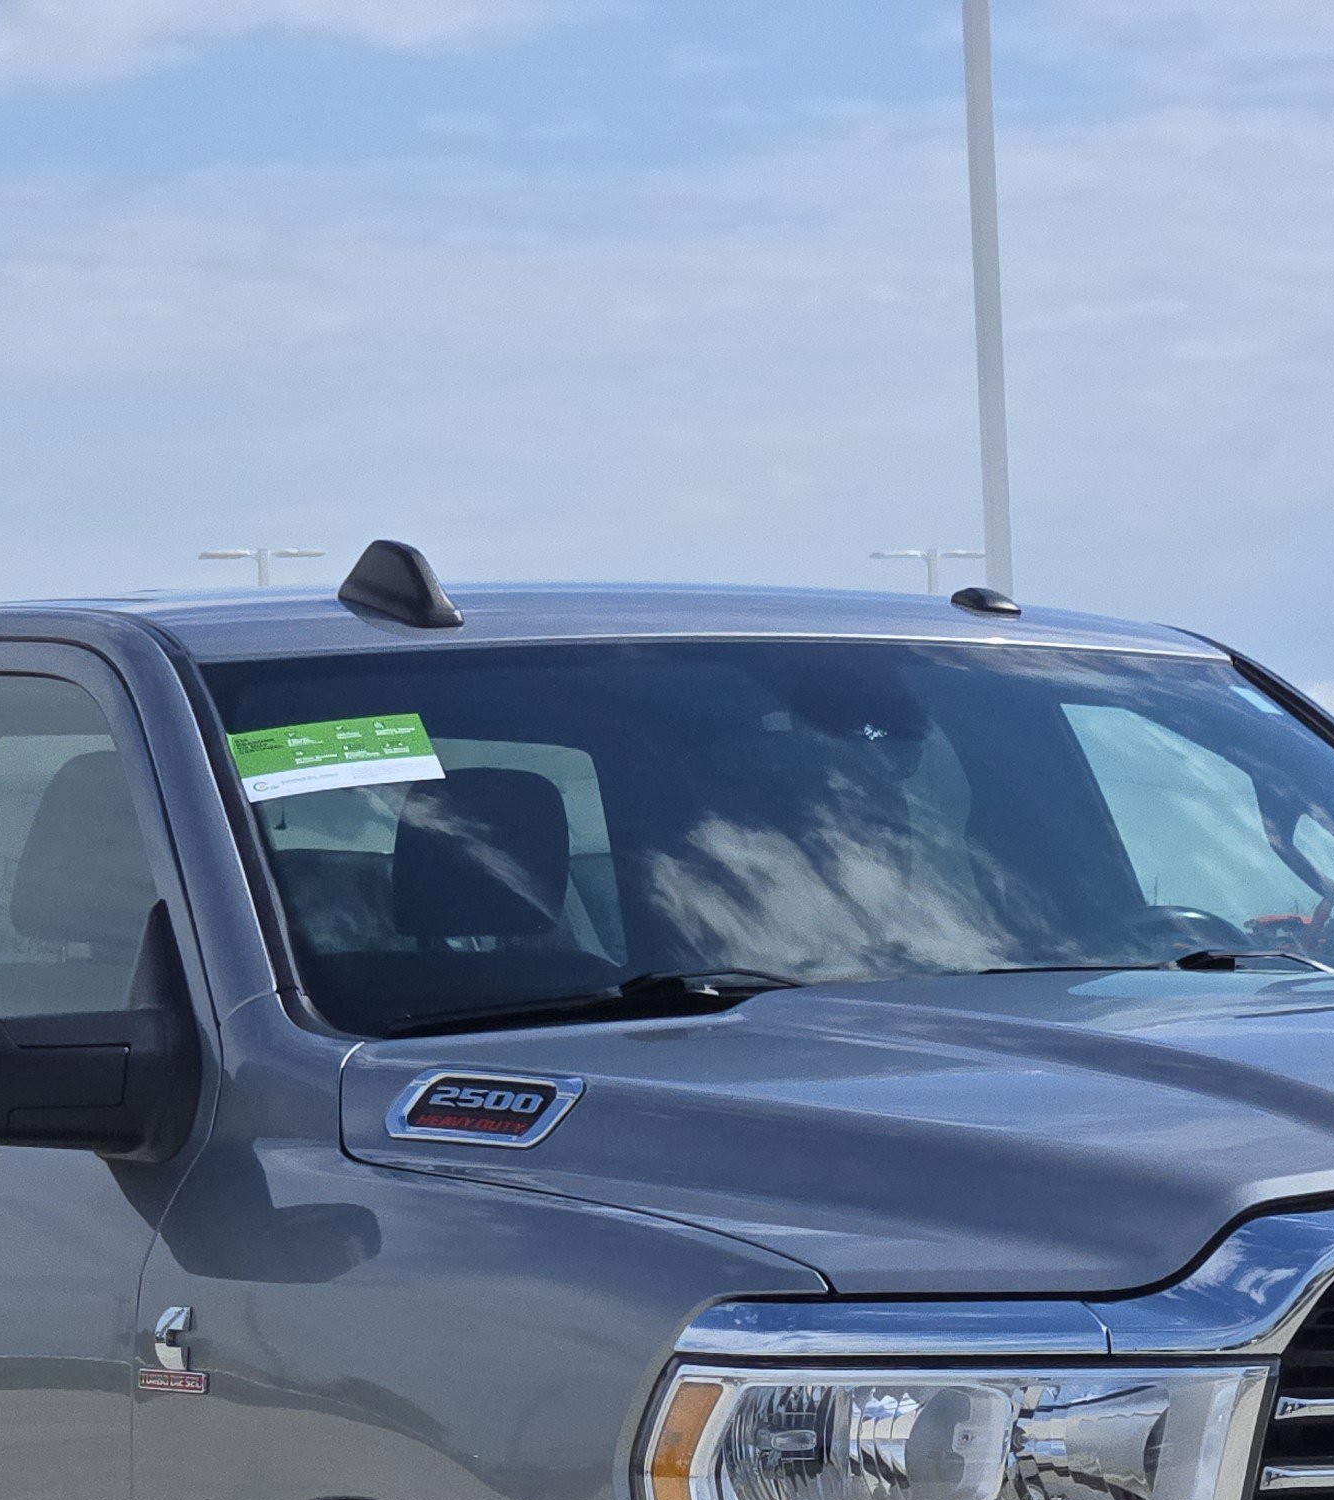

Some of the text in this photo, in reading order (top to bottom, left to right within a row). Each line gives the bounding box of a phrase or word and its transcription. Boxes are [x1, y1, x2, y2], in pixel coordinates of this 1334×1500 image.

[428, 1085, 544, 1114] 2500
[415, 1114, 528, 1135] HEAVY DUTY
